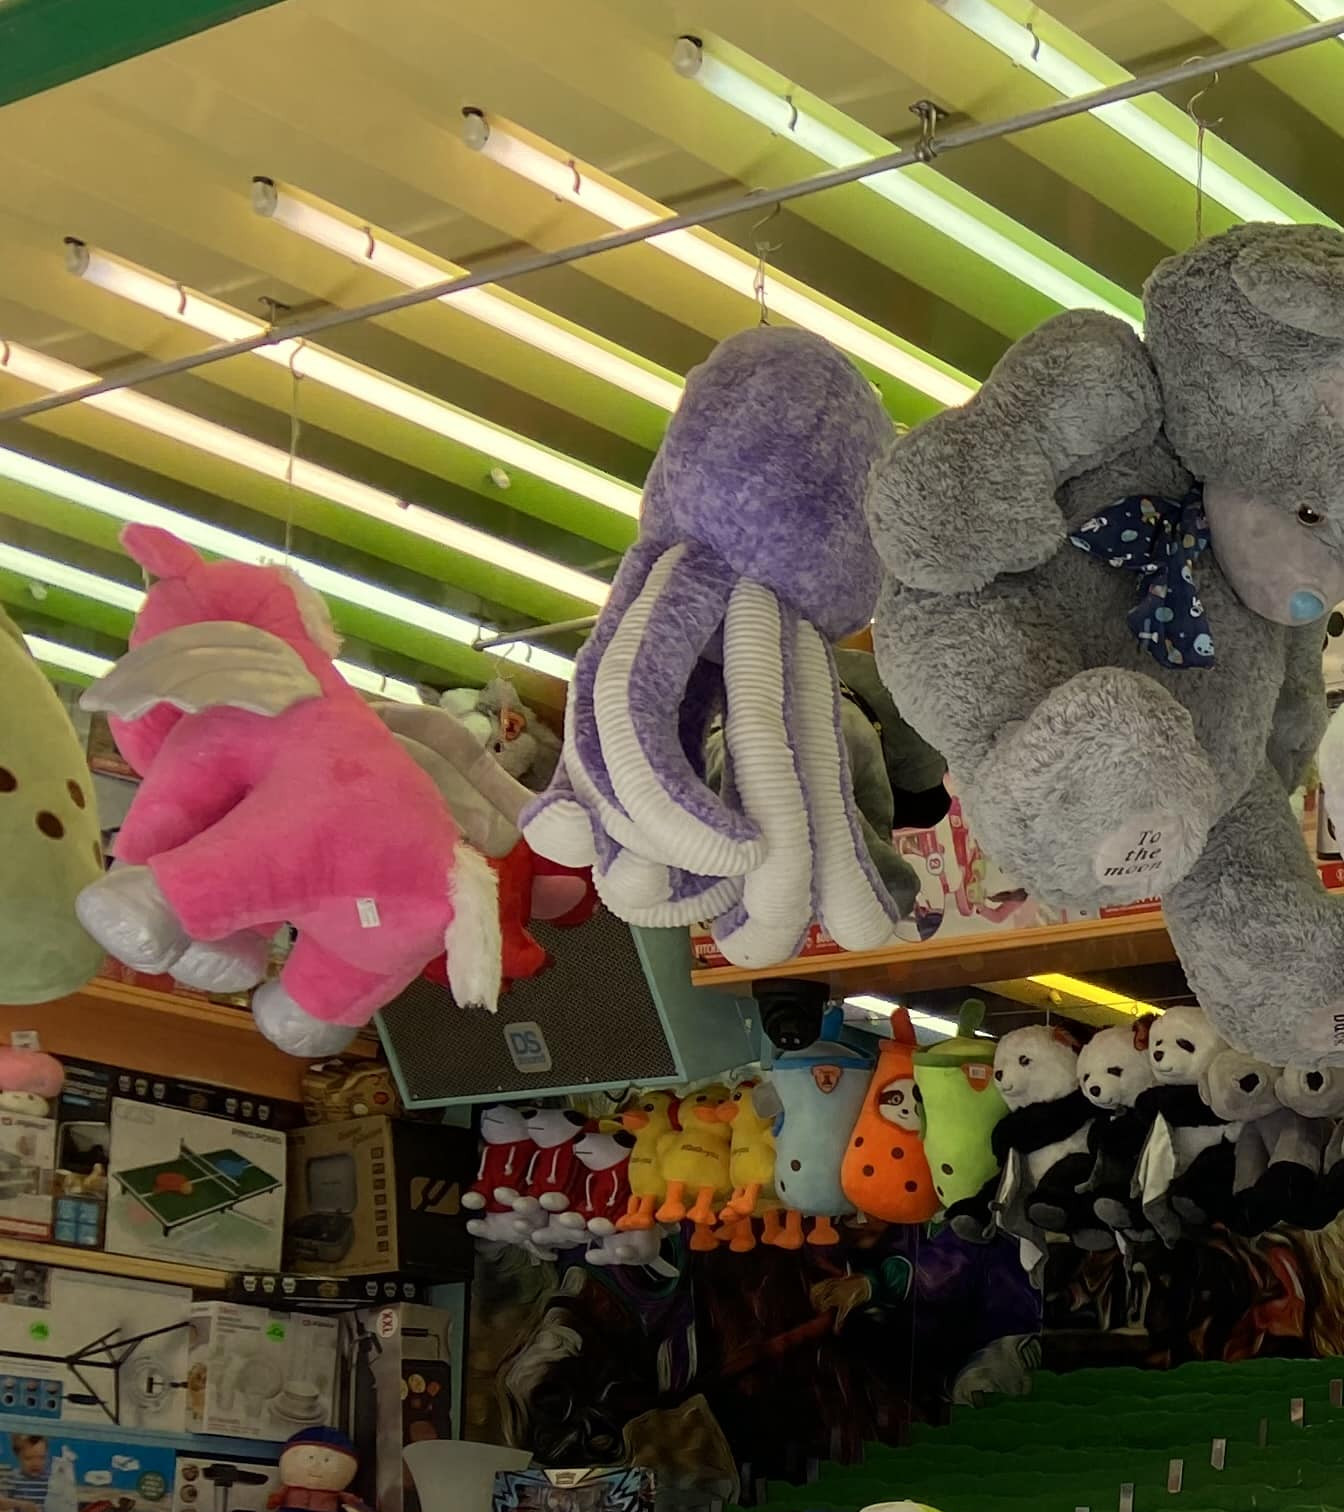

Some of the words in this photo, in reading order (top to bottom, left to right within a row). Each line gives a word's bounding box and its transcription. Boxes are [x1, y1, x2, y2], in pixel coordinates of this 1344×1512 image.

[1137, 829, 1161, 846] To
[1125, 845, 1161, 861] the
[1103, 860, 1163, 877] moon
[511, 1030, 541, 1054] DS
[382, 1311, 393, 1334] XXL
